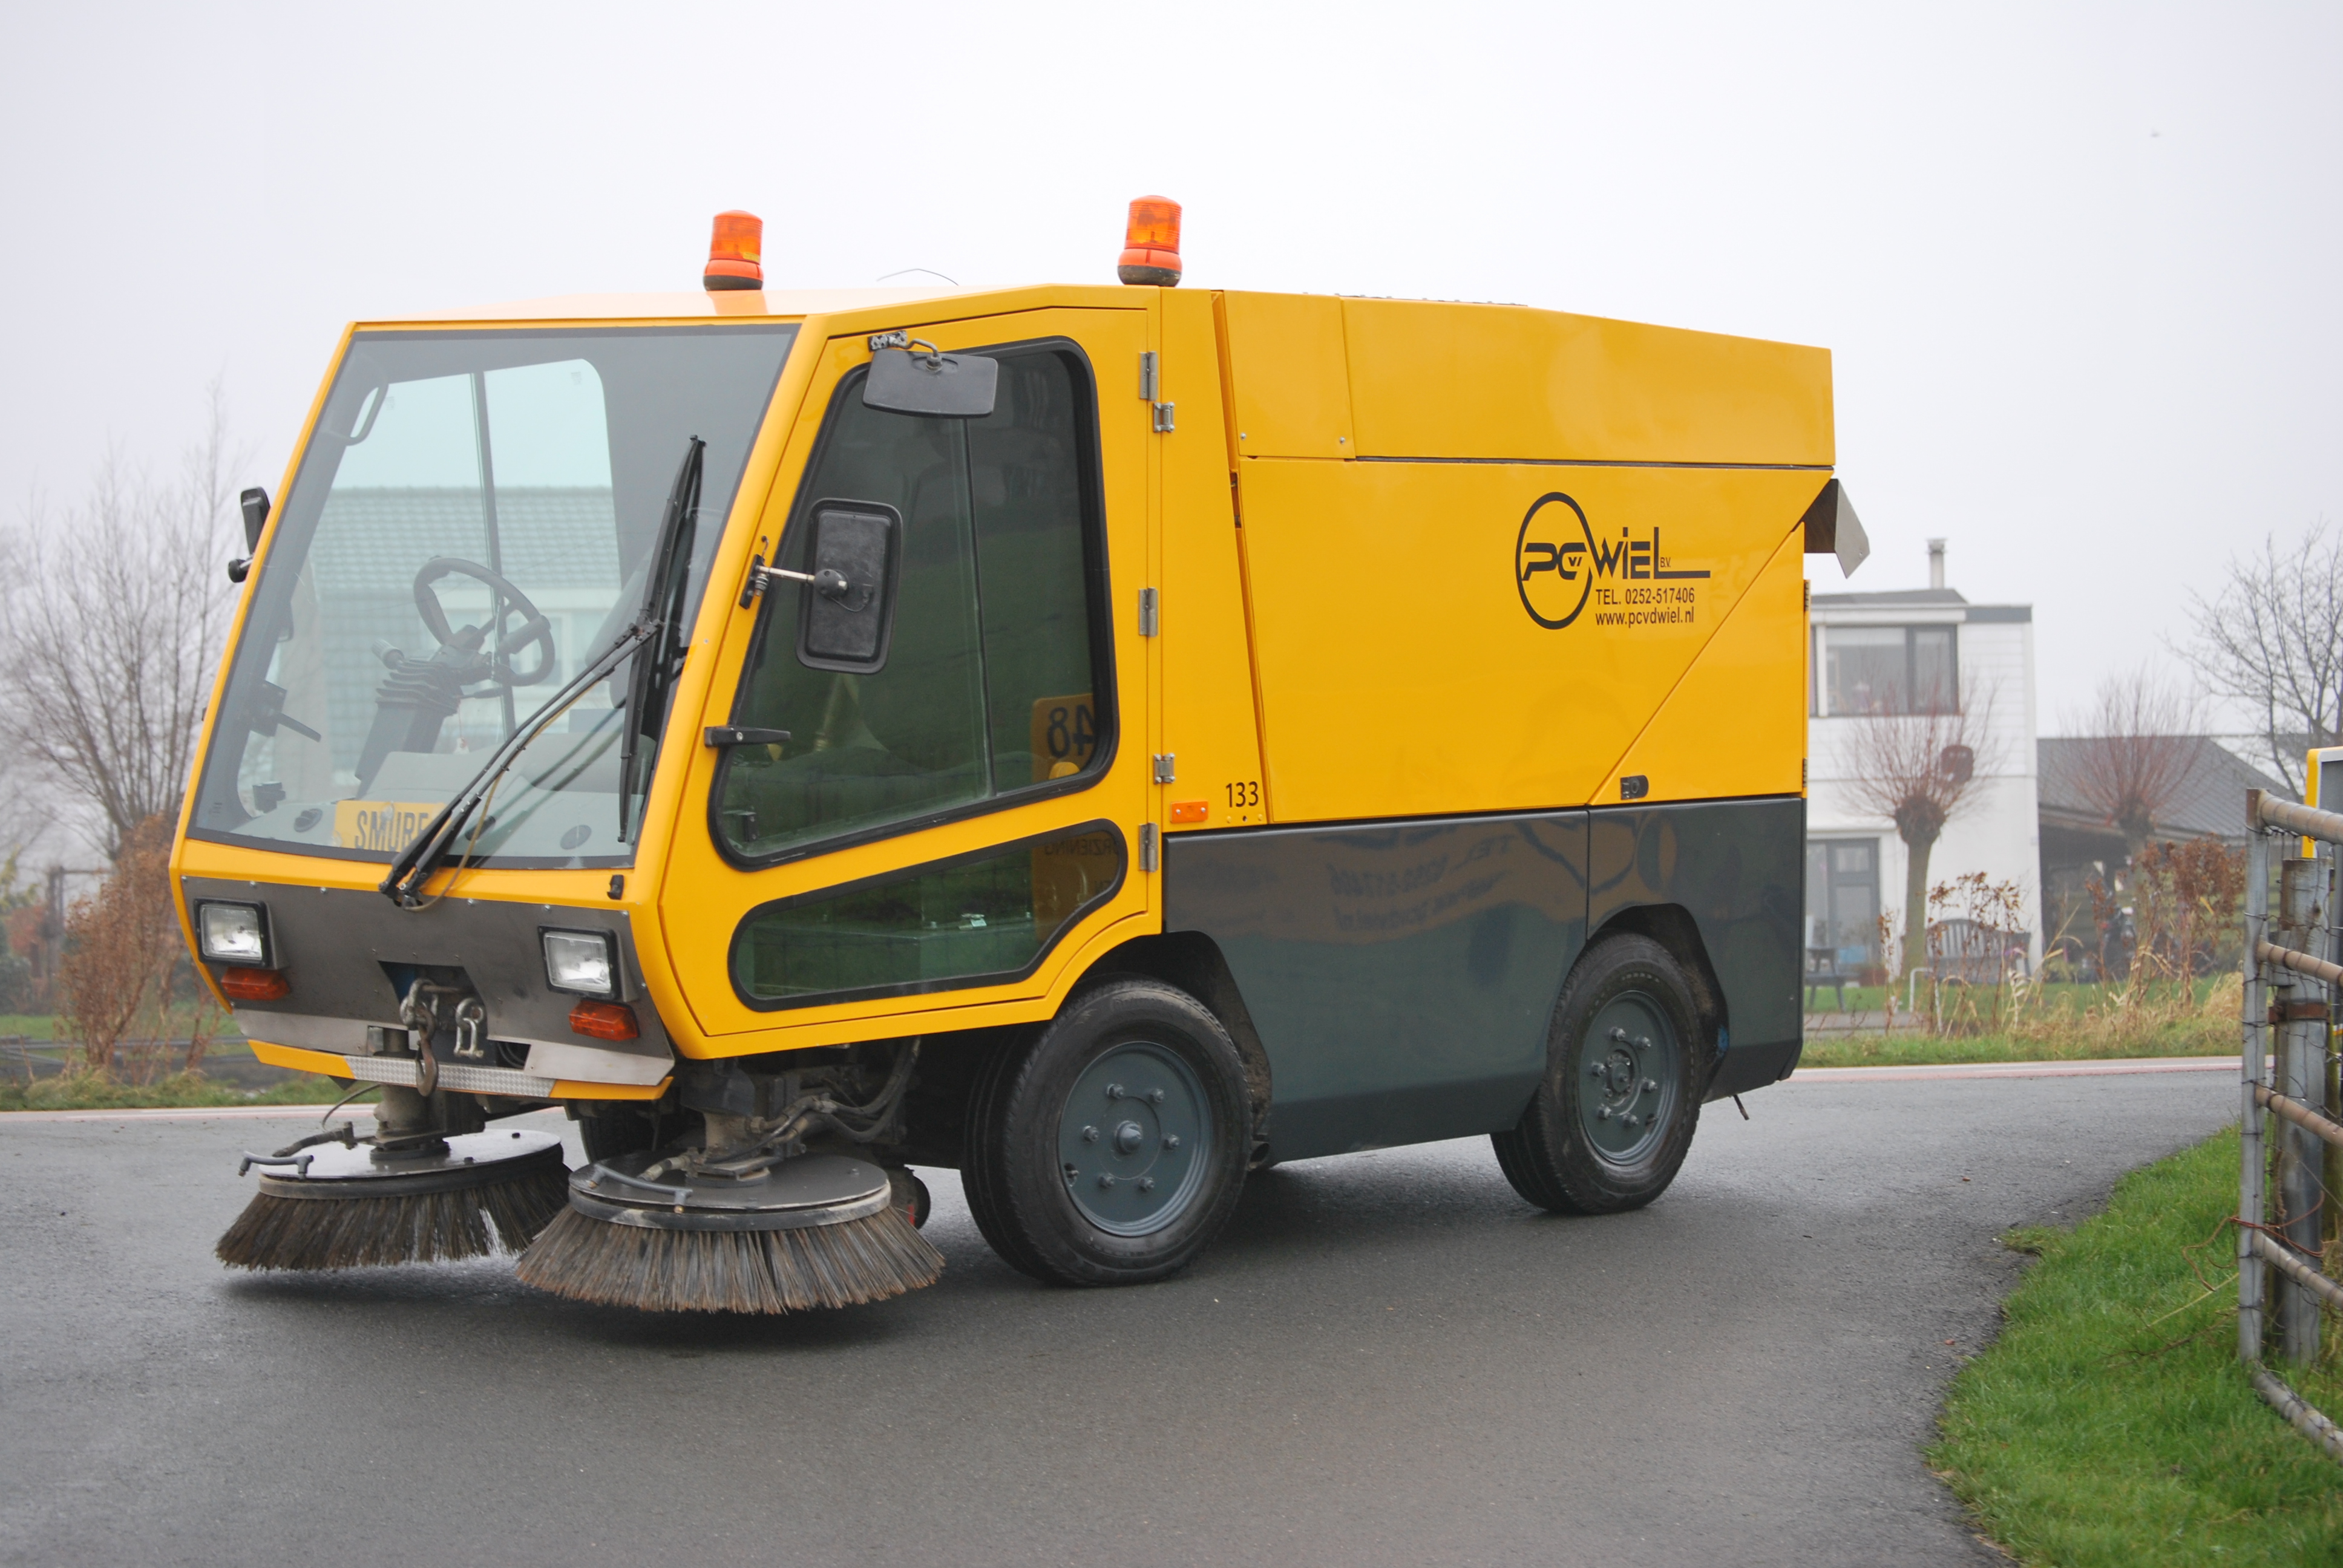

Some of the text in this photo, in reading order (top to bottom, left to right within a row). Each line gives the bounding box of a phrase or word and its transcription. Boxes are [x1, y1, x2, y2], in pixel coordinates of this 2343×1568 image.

[1595, 587, 1695, 605] TEL. 0252-517406
[1595, 606, 1694, 629] www.pcvdwiel.nl
[1225, 781, 1259, 808] 133
